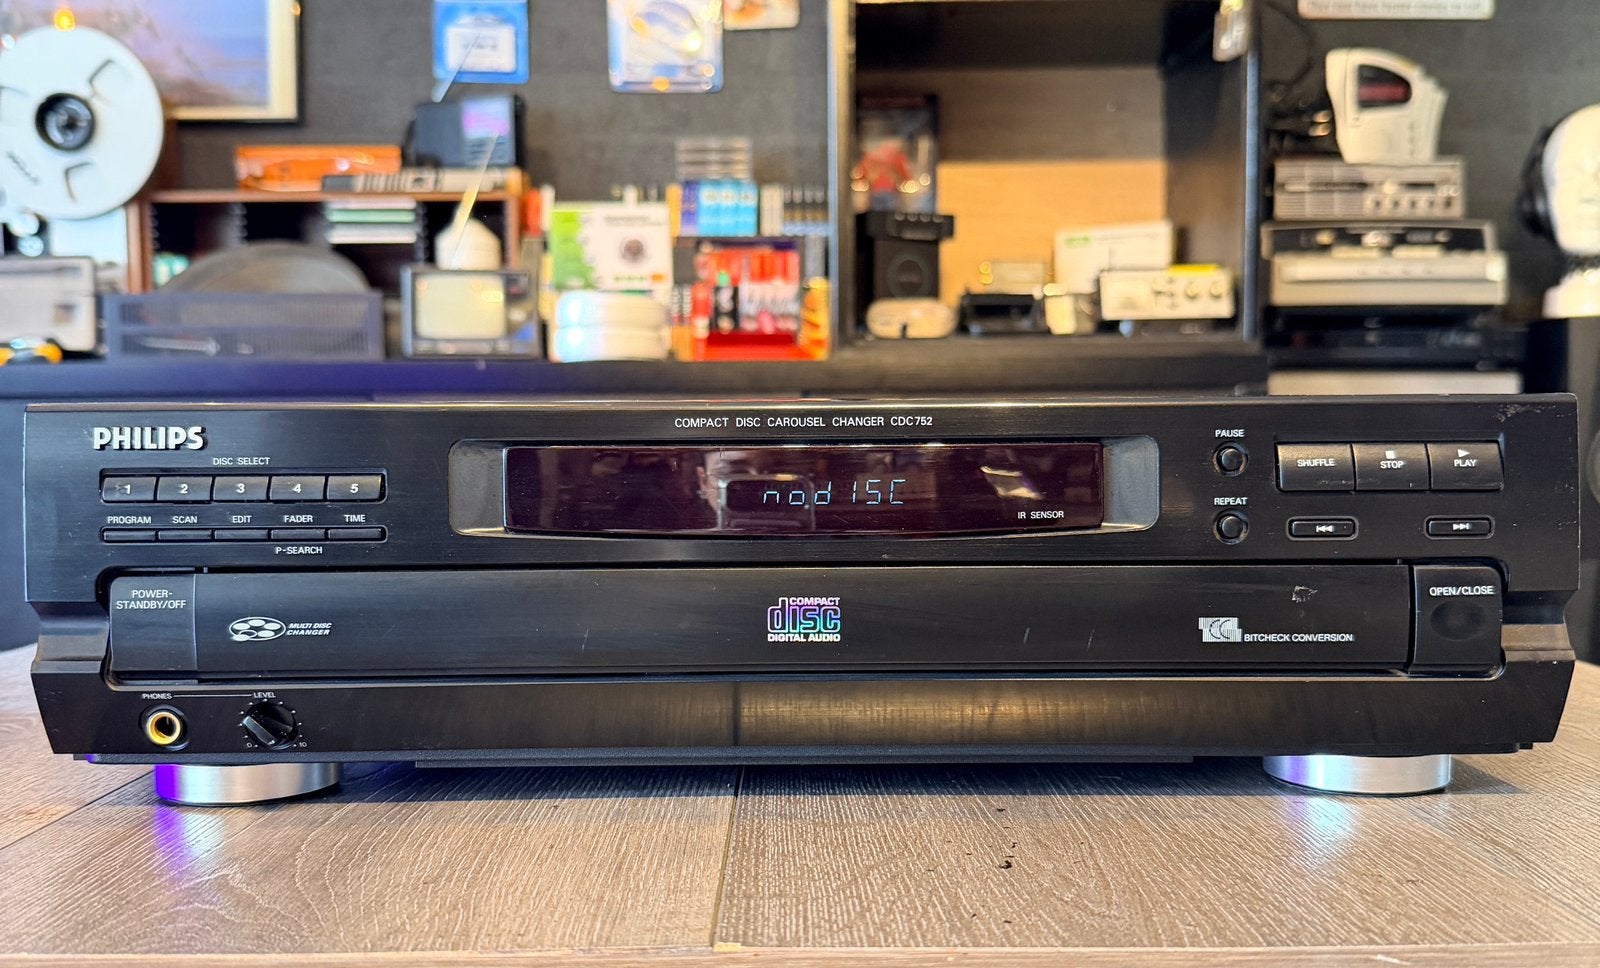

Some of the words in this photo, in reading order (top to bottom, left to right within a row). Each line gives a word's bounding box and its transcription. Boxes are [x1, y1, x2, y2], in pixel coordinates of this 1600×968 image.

[674, 417, 729, 428] COMPACT
[735, 417, 761, 428] DISC
[767, 416, 826, 428] CAROUSEL
[832, 416, 885, 427] CHANGER
[92, 426, 206, 450] PHILIPS
[1214, 428, 1245, 438] PAUSE
[212, 456, 234, 467] DISC
[237, 456, 271, 466] SELECT
[1296, 458, 1336, 468] SHUFFLE
[1379, 459, 1405, 470] STOP
[1453, 458, 1478, 468] PLAY
[123, 483, 132, 495] 1
[180, 483, 189, 495] 2
[236, 483, 246, 495] 3
[292, 483, 302, 495] 4
[349, 483, 360, 495] 5
[1213, 496, 1248, 506] REPEAT
[107, 515, 152, 524] PROGRAM
[172, 515, 198, 524] SCAN
[232, 514, 252, 523] EDIT
[284, 514, 314, 523] FADER
[344, 514, 366, 523] TIME
[1017, 510, 1026, 520] IR
[1030, 510, 1065, 520] SENSOR
[275, 546, 323, 555] P-SEARCH
[131, 589, 173, 599] POWER-
[1429, 585, 1495, 597] OPEN/CLOSE
[116, 600, 187, 609] STANDBY/OFF
[789, 597, 841, 606] COMPACT
[767, 633, 807, 642] DIGITAL
[807, 633, 841, 642] AUDIO
[1243, 633, 1290, 642] BITCHECK
[1291, 633, 1354, 642] CONVERSION
[142, 692, 173, 700] PHONES
